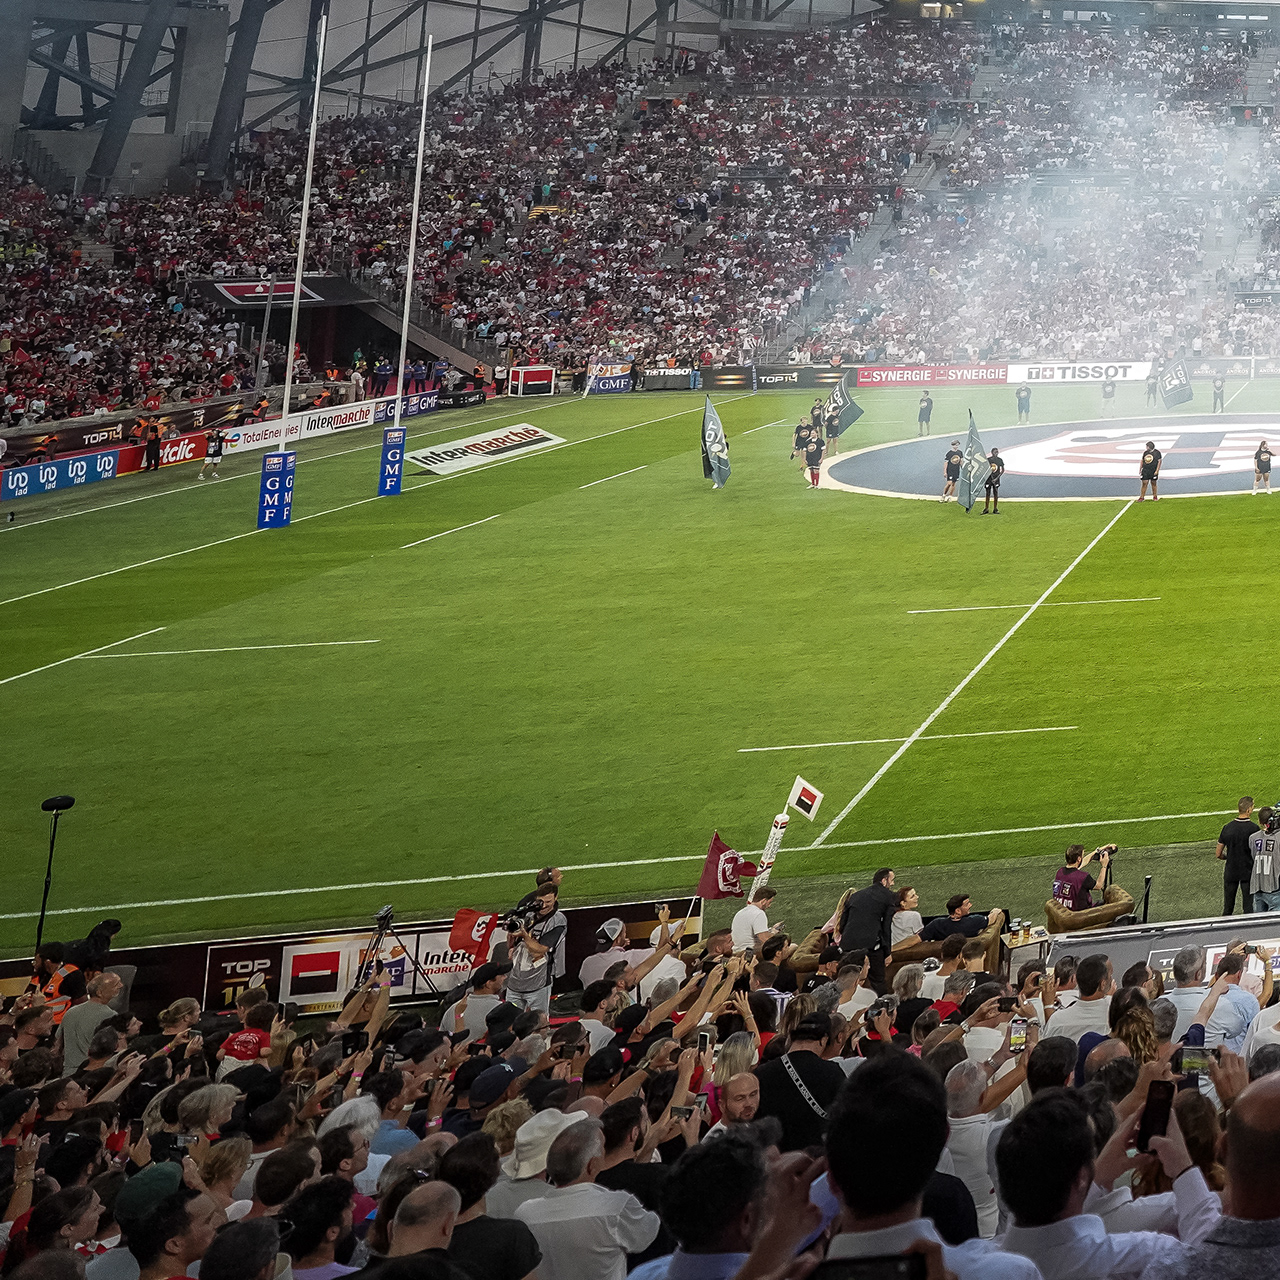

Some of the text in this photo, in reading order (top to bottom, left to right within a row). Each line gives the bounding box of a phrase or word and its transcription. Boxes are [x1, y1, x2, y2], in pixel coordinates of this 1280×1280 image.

[760, 372, 798, 384] TOP14
[872, 368, 1006, 382] SYNERGIE SYNERGIE
[1056, 365, 1132, 379] TISSOT
[599, 378, 630, 390] GMF
[386, 400, 406, 417] GF
[420, 396, 438, 410] GMF
[83, 430, 122, 446] TOP14
[1256, 855, 1273, 876] TV
[222, 958, 272, 974] TOP
